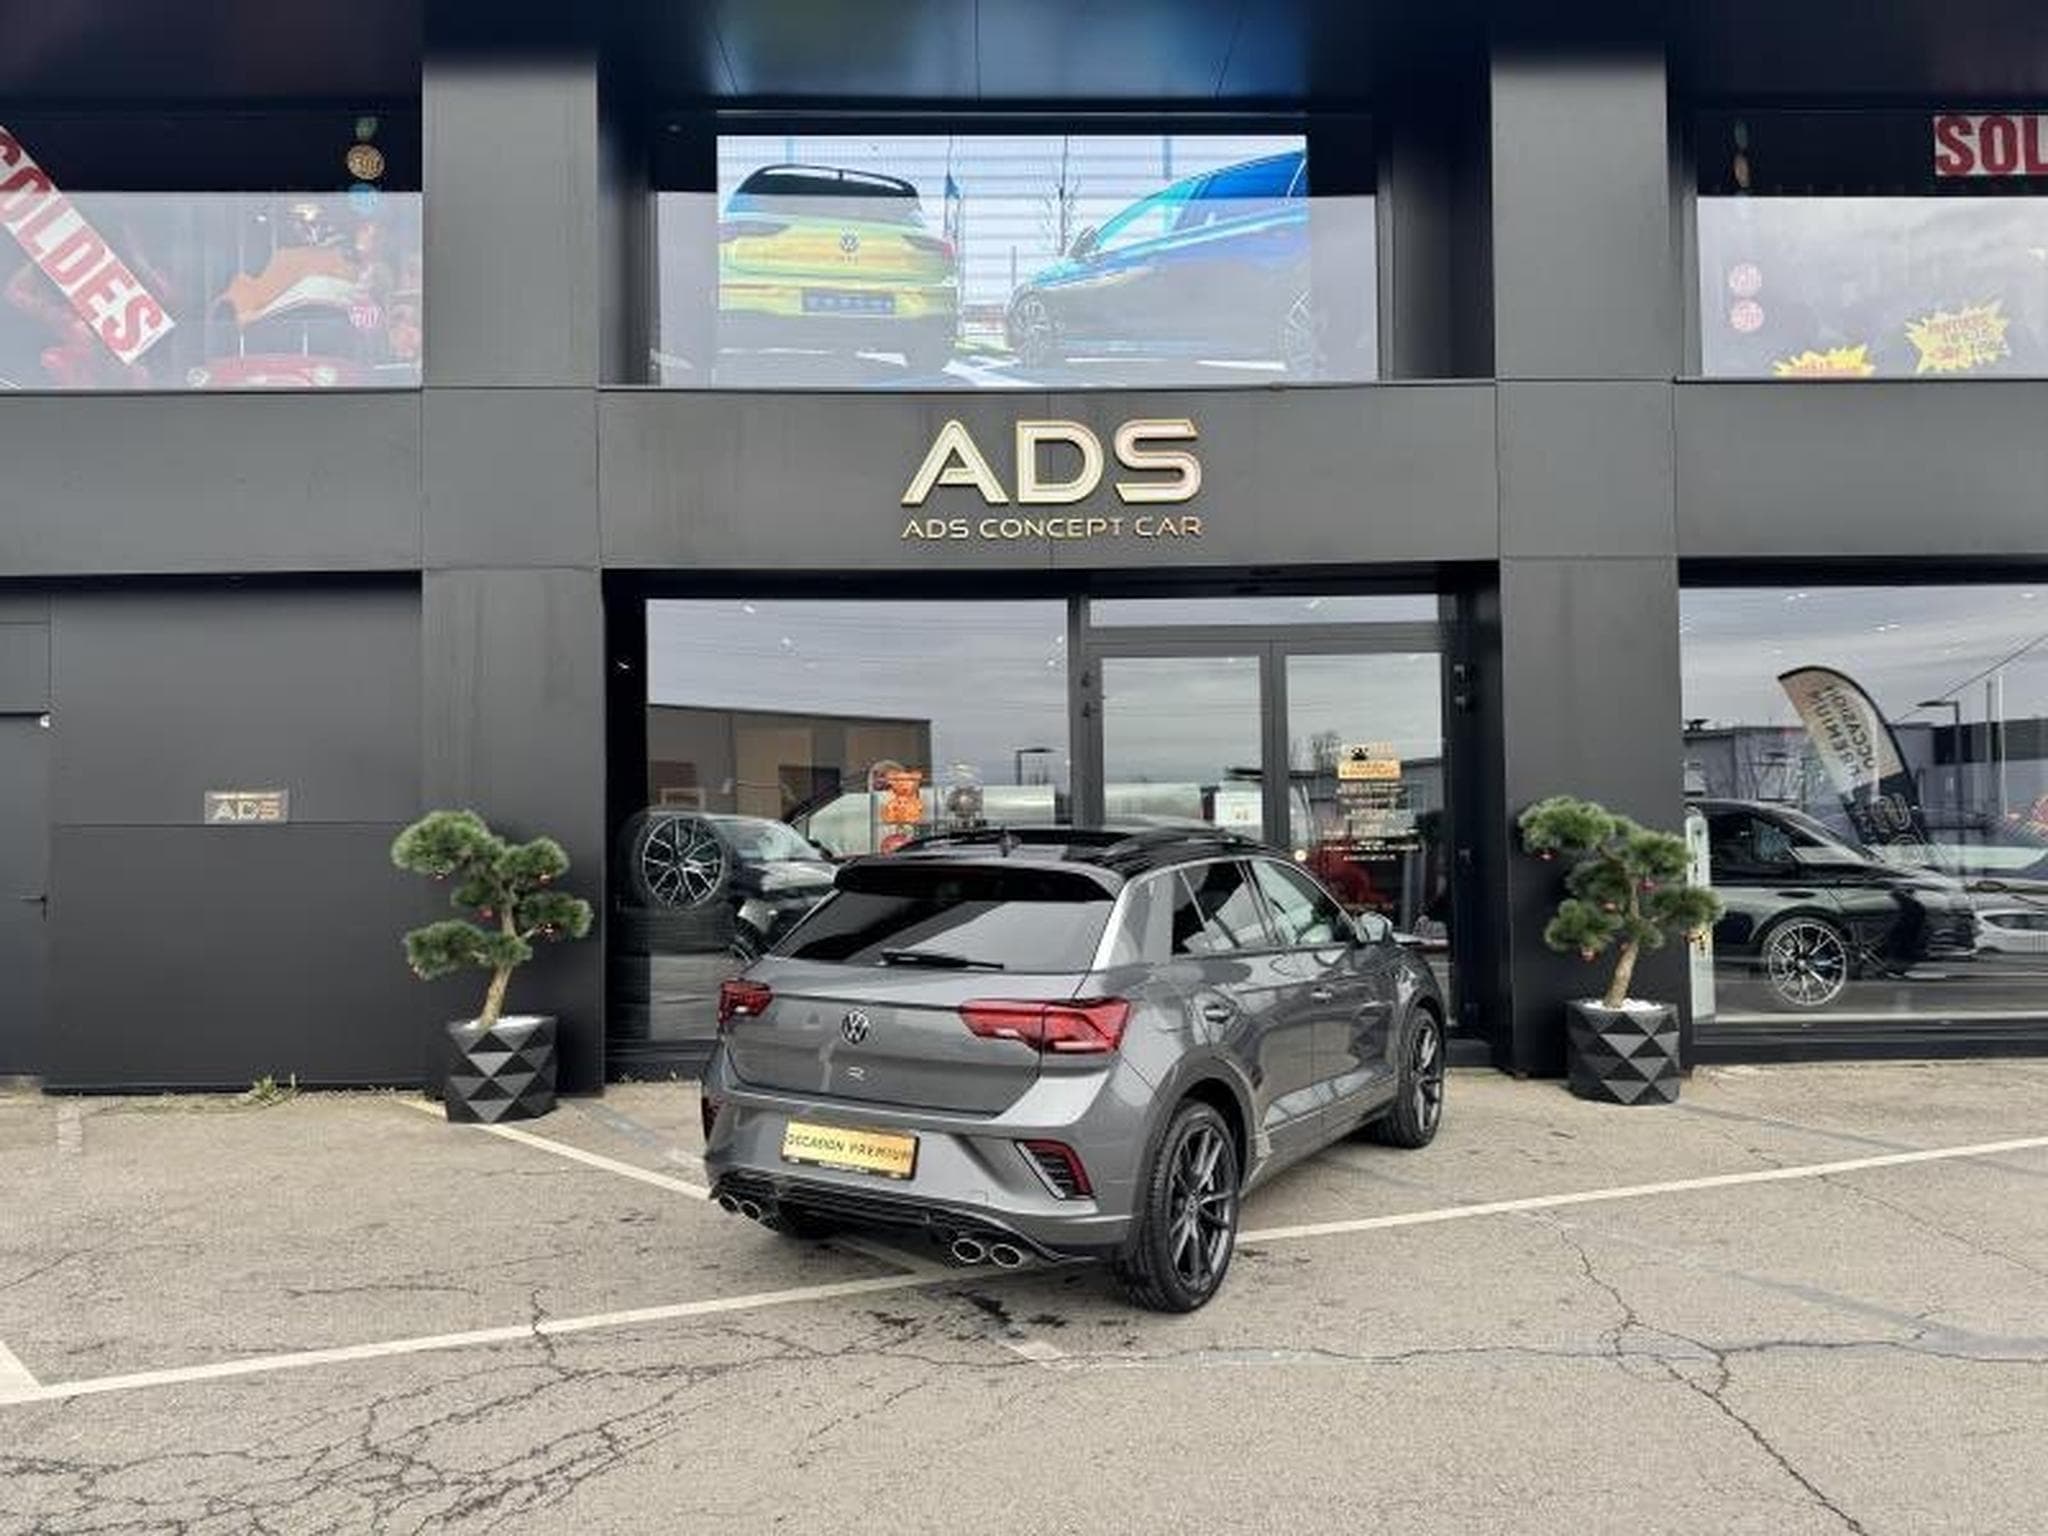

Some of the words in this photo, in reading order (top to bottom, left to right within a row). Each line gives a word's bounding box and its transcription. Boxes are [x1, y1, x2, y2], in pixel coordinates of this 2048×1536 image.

[901, 419, 1201, 504] ADS
[901, 518, 968, 538] ADS
[980, 517, 1123, 538] CONCEPT
[1135, 516, 1201, 537] CAR
[213, 800, 280, 820] ADS
